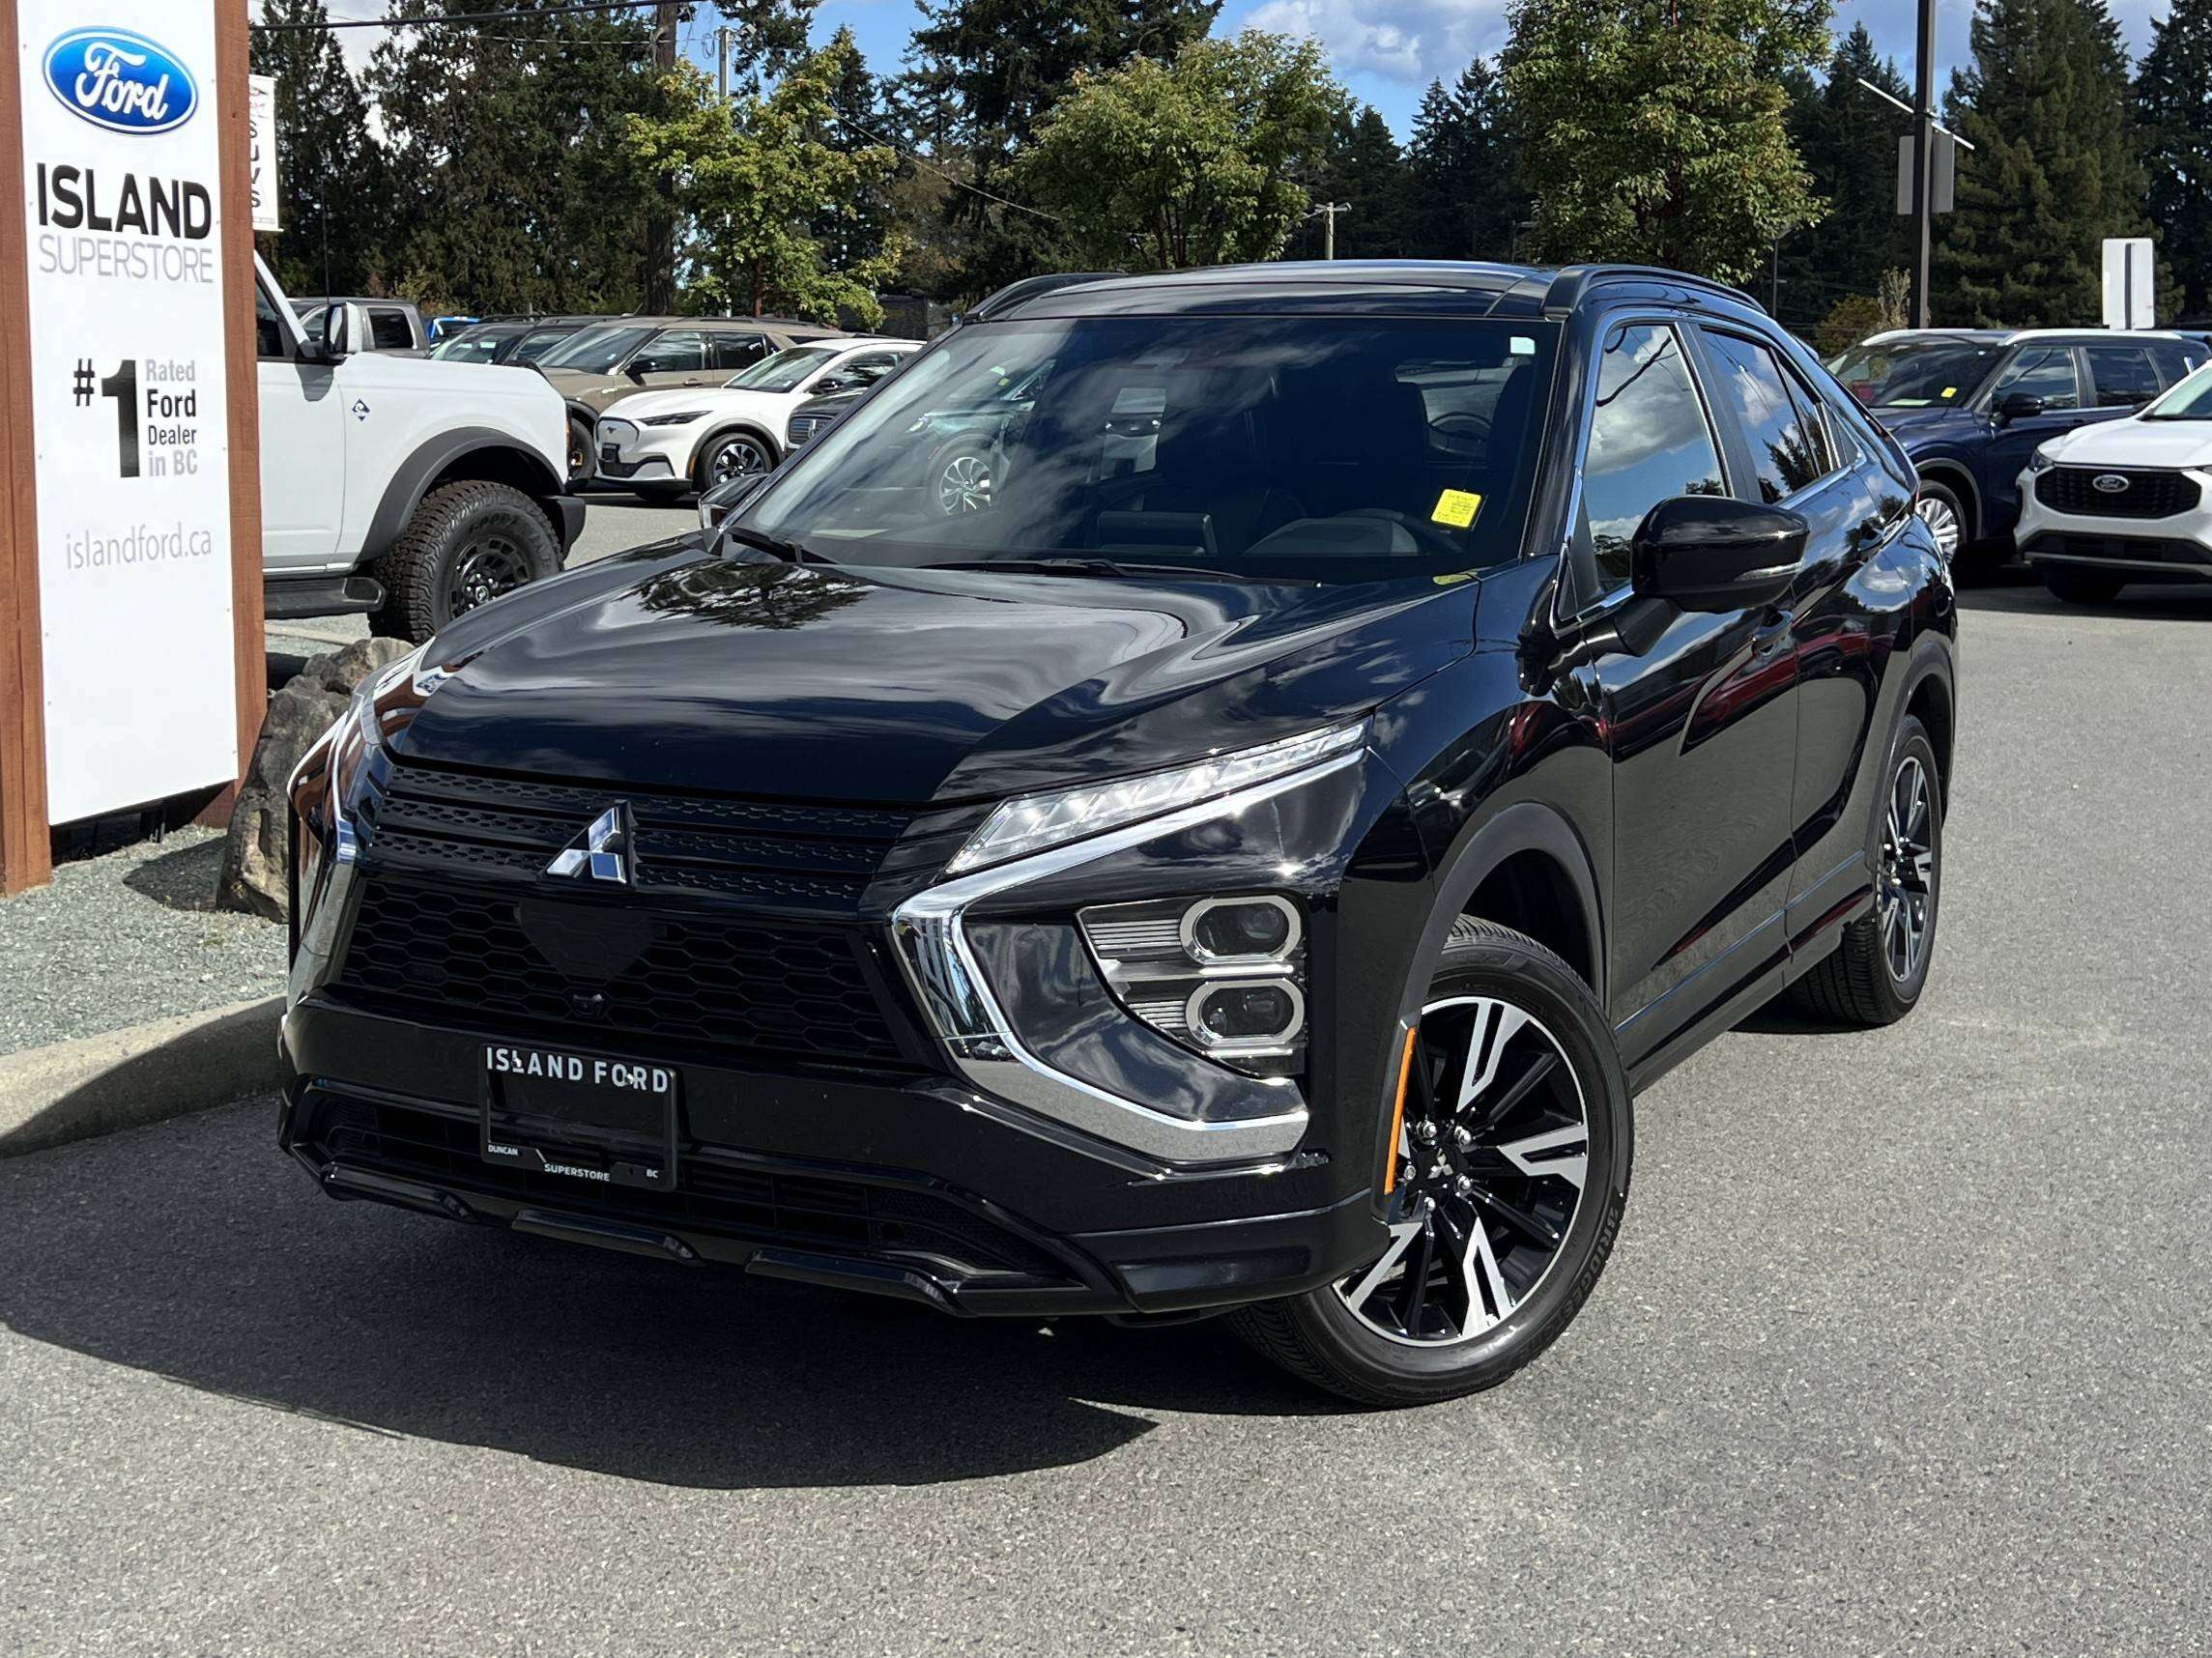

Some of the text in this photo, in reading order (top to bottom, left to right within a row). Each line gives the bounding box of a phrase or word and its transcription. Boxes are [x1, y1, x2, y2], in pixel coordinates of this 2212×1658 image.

[74, 42, 170, 121] Ford
[37, 162, 212, 240] ISLAND
[39, 234, 214, 283] SUPERSTORE
[145, 358, 196, 383] Rated
[73, 358, 140, 478] #1
[147, 388, 197, 418] Ford
[148, 424, 197, 445] Dealer
[148, 449, 198, 476] in BC
[66, 522, 213, 570] islandford.ca
[486, 1046, 669, 1093] ISLAND FORD
[487, 1144, 519, 1157] DUNCAN
[543, 1162, 611, 1182] SUPERSTORE
[646, 1168, 659, 1179] BC
